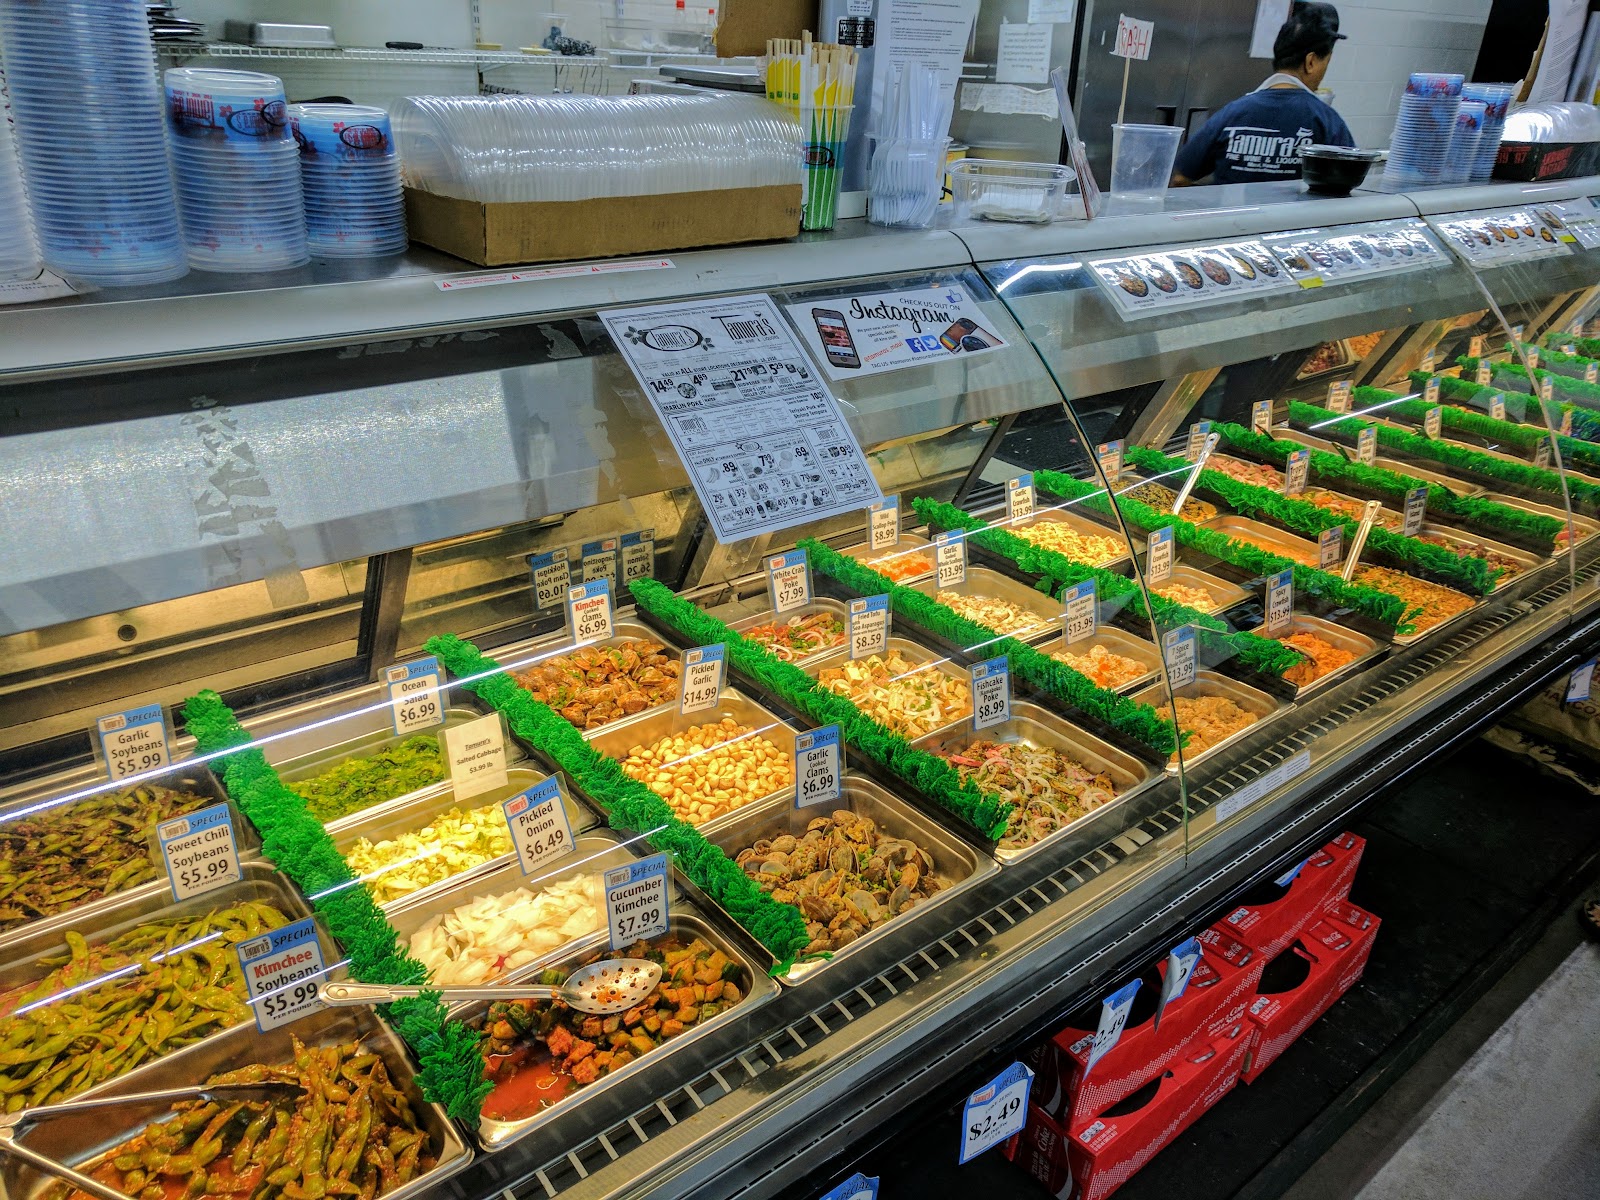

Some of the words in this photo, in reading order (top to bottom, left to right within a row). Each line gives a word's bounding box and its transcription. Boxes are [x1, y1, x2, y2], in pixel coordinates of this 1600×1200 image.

[1117, 20, 1149, 58] TRASH
[1243, 154, 1261, 163] WINE
[1275, 156, 1303, 165] LIQUOR
[850, 298, 955, 333] Instagram
[711, 310, 776, 341] Tamura's
[681, 366, 694, 375] ALL
[663, 403, 686, 411] MARLIN
[687, 401, 703, 409] POKE
[1011, 505, 1032, 519] $13.99
[874, 528, 895, 542] $8.99
[773, 569, 791, 581] White
[791, 565, 806, 576] Crab
[939, 564, 963, 581] $13.99
[1150, 560, 1170, 577] $13.99
[783, 580, 799, 590] Poke
[779, 586, 804, 604] $7.99
[575, 598, 605, 612] Kimchee
[1270, 605, 1290, 623] $13.99
[581, 612, 603, 623] Clams
[1068, 616, 1093, 636] $13.99
[578, 618, 607, 638] $6.99
[856, 633, 882, 650] $8.59
[409, 663, 438, 675] SPECIAL
[690, 662, 716, 676] Pickled
[401, 680, 427, 692] Ocean
[692, 674, 713, 687] Garlic
[976, 676, 1004, 691] Fishcake
[683, 686, 717, 706] $14.99
[983, 693, 999, 704] Poke
[127, 710, 163, 724] SPECIAL
[399, 702, 436, 724] $6.99
[978, 699, 1005, 720] $8.99
[118, 729, 150, 744] Garlic
[814, 731, 838, 746] SPECIAL
[111, 740, 164, 759] Soybeans
[456, 754, 476, 766] Salted
[476, 747, 502, 759] Cabbage
[807, 748, 829, 762] Garlic
[117, 752, 161, 776] $5.99
[806, 766, 829, 779] Clams
[528, 783, 559, 804] SPECIAL
[803, 774, 834, 796] $6.99
[191, 811, 229, 829] SPECIAL
[519, 802, 554, 827] Pickled
[526, 818, 555, 838] Onion
[167, 837, 203, 855] Sweet
[204, 826, 230, 842] Chili
[526, 829, 565, 862] $6.49
[172, 844, 230, 869] Soybeans
[180, 859, 229, 887] $5.99
[632, 861, 667, 878] SPECIAL
[610, 879, 662, 903] Cucumber
[615, 893, 660, 915] Kimchee
[617, 908, 660, 937] $7.99
[273, 926, 317, 948] SPECIAL
[253, 950, 313, 979] Kimchee
[256, 964, 321, 995] Soybeans
[263, 982, 319, 1017] $5.99
[288, 1003, 312, 1015] POUND
[969, 1097, 1021, 1141] $2.49
